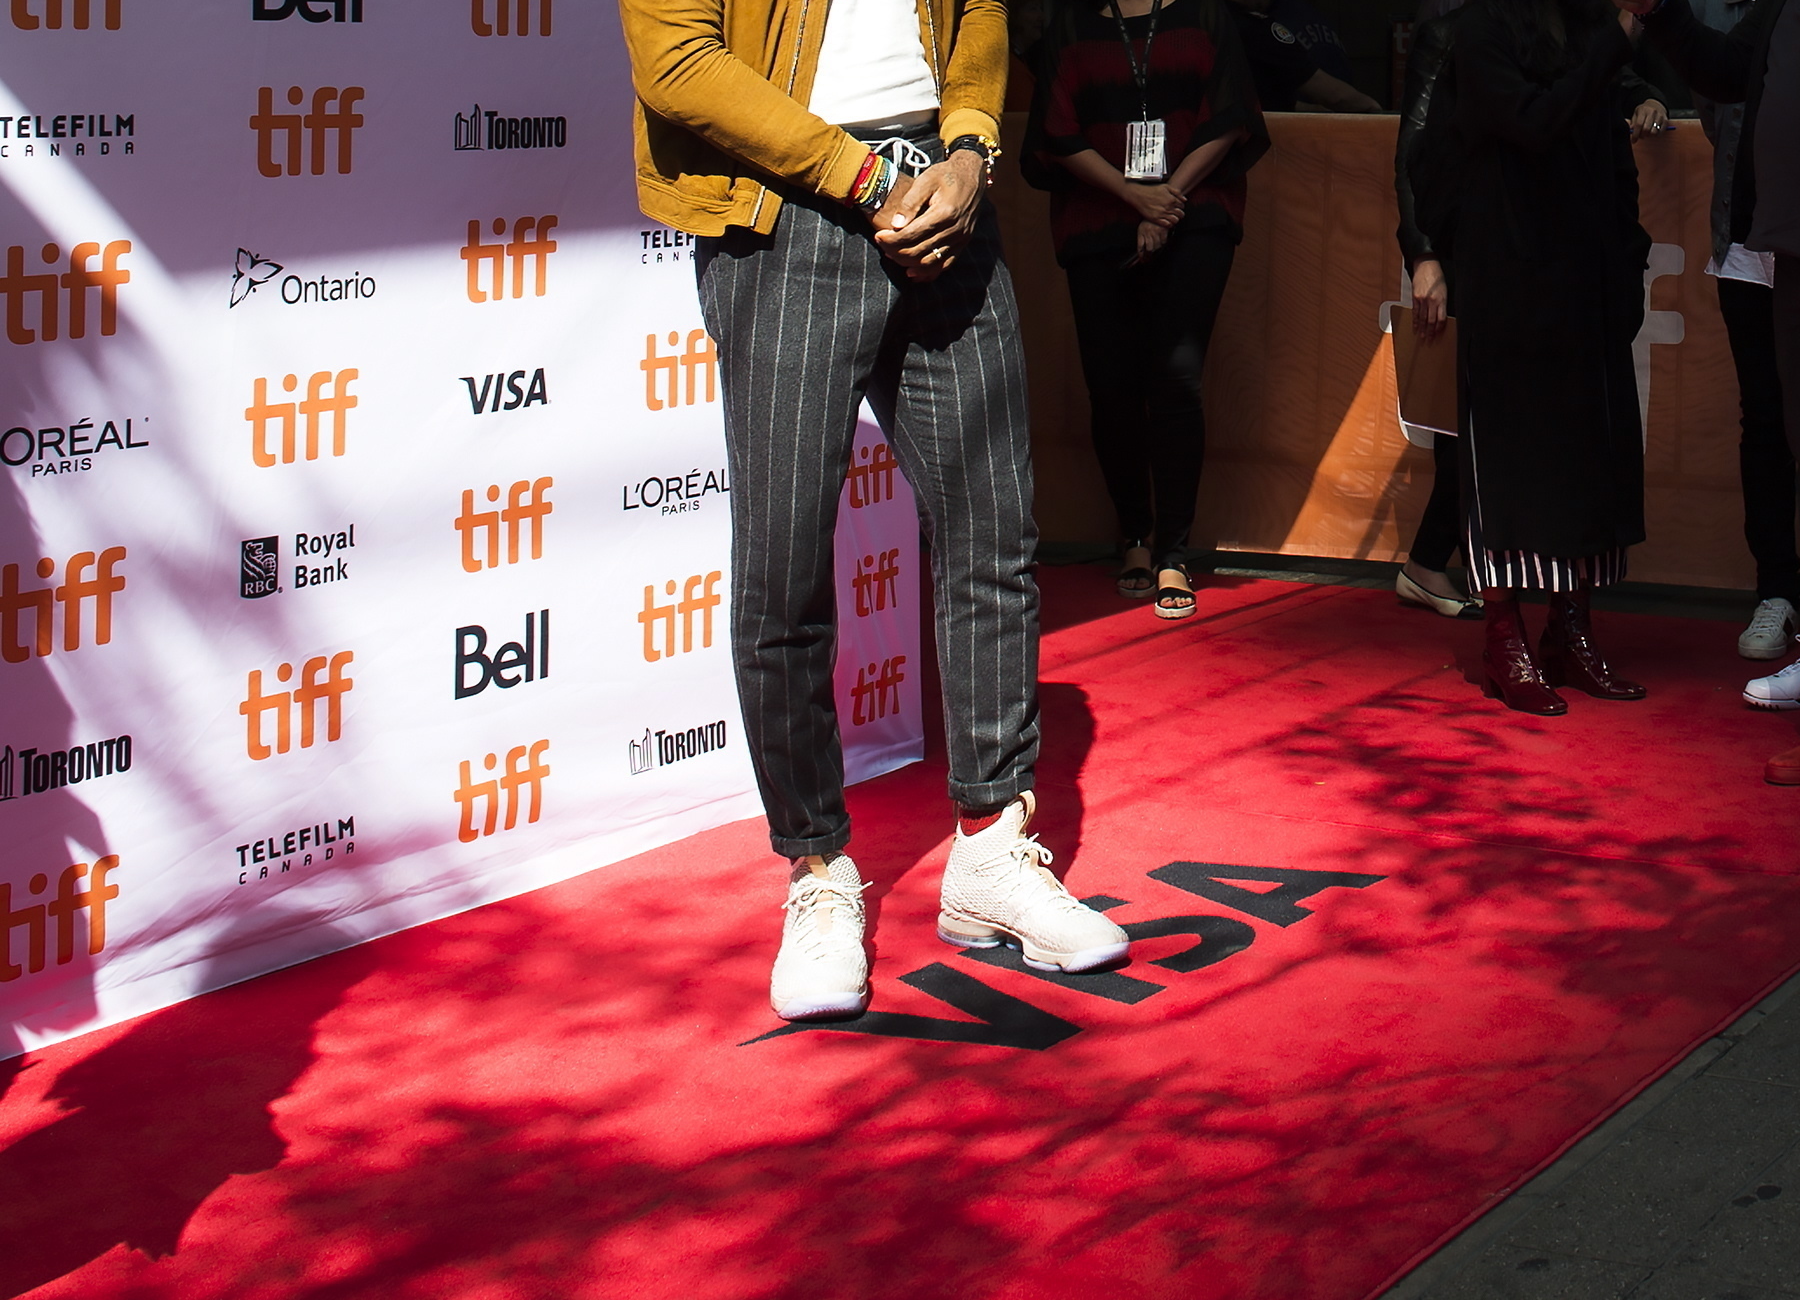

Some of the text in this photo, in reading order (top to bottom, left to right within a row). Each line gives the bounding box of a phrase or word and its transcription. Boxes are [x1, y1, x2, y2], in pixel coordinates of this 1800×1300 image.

[0, 114, 134, 138] TELEFILM
[0, 141, 134, 157] CANADA
[250, 86, 364, 177] tiff
[485, 111, 566, 149] TORONTO
[461, 215, 558, 302] tiff
[641, 230, 694, 249] TELEF
[642, 250, 695, 265] CANA
[0, 240, 131, 344] tiff
[281, 270, 376, 305] Ontario
[459, 368, 547, 414] VISA
[0, 417, 149, 466] ORÉAL
[246, 369, 358, 467] tiff
[32, 457, 92, 477] PARIS
[624, 466, 731, 510] L'ORÉAL
[849, 443, 899, 509] tiff
[455, 477, 552, 572] tiff
[661, 500, 700, 516] PARIS
[296, 523, 355, 558] Royal
[245, 579, 275, 595] RBC
[295, 557, 348, 588] Bank
[852, 548, 899, 617] tiff
[0, 547, 126, 663] tiff
[638, 571, 721, 662] tiff
[455, 609, 549, 700] Bell
[240, 651, 353, 760] tiff
[851, 655, 906, 726] tiff
[19, 735, 132, 796] TORONTO
[655, 720, 726, 766] TORONTO
[454, 740, 549, 842] tiff
[236, 816, 355, 867] TELEFILM
[239, 841, 354, 885] CANADA
[0, 855, 119, 982] tiff
[738, 860, 1388, 1051] VISA
